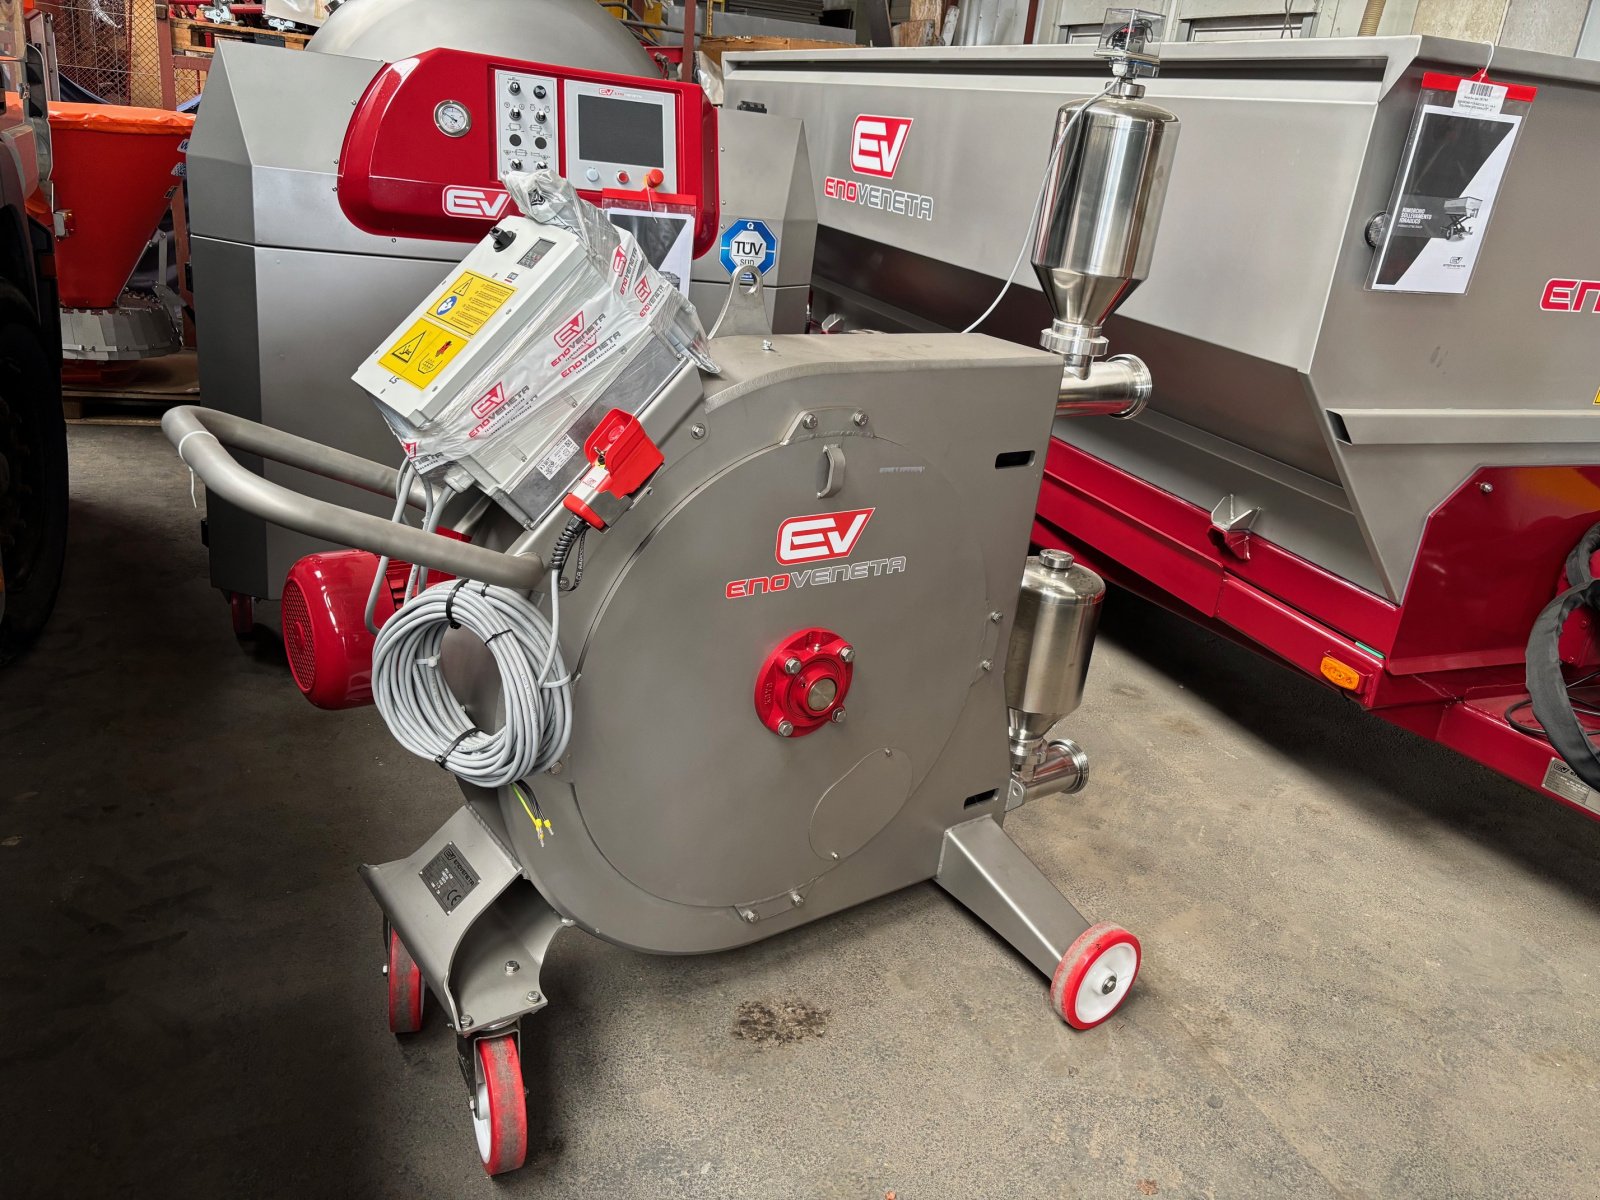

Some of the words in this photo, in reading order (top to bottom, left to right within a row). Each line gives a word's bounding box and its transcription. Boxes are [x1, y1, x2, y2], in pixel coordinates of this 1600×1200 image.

[850, 115, 913, 178] EV
[444, 186, 510, 219] EV
[824, 176, 934, 221] ENOVENETA
[734, 241, 763, 255] TÜV
[746, 222, 755, 230] Q
[551, 313, 606, 367] ENOVENETA
[561, 331, 621, 378] ENOVENETA
[468, 385, 530, 439] ENOVENETA
[471, 381, 505, 420] EV
[776, 508, 875, 565] EV
[725, 556, 907, 599] ENOVENETA
